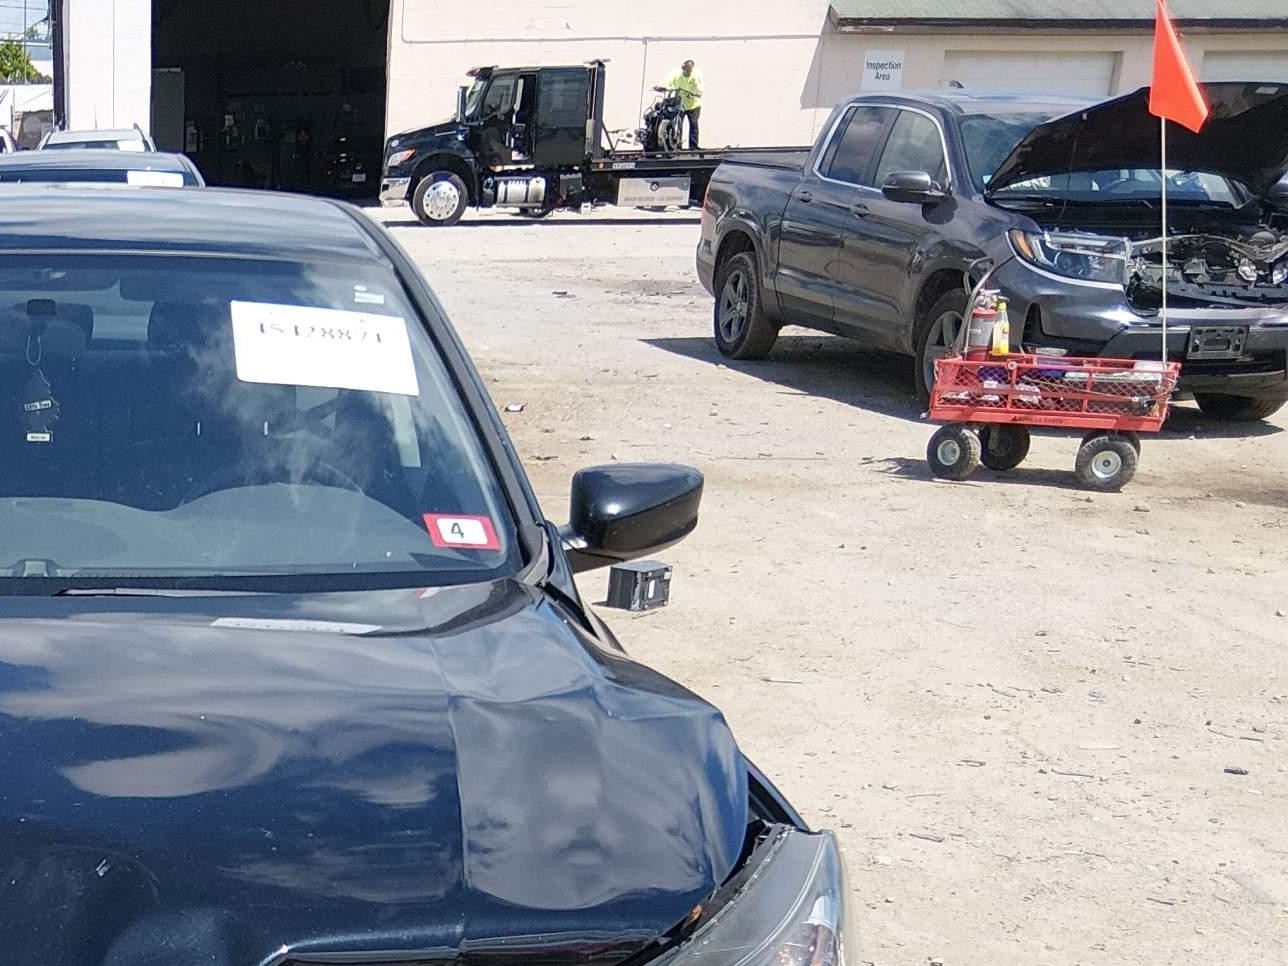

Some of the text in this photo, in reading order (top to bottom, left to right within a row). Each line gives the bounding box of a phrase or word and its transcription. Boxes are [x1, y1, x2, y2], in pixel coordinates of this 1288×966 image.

[865, 60, 902, 71] Inspection
[874, 71, 891, 81] Area
[450, 522, 465, 539] 4
